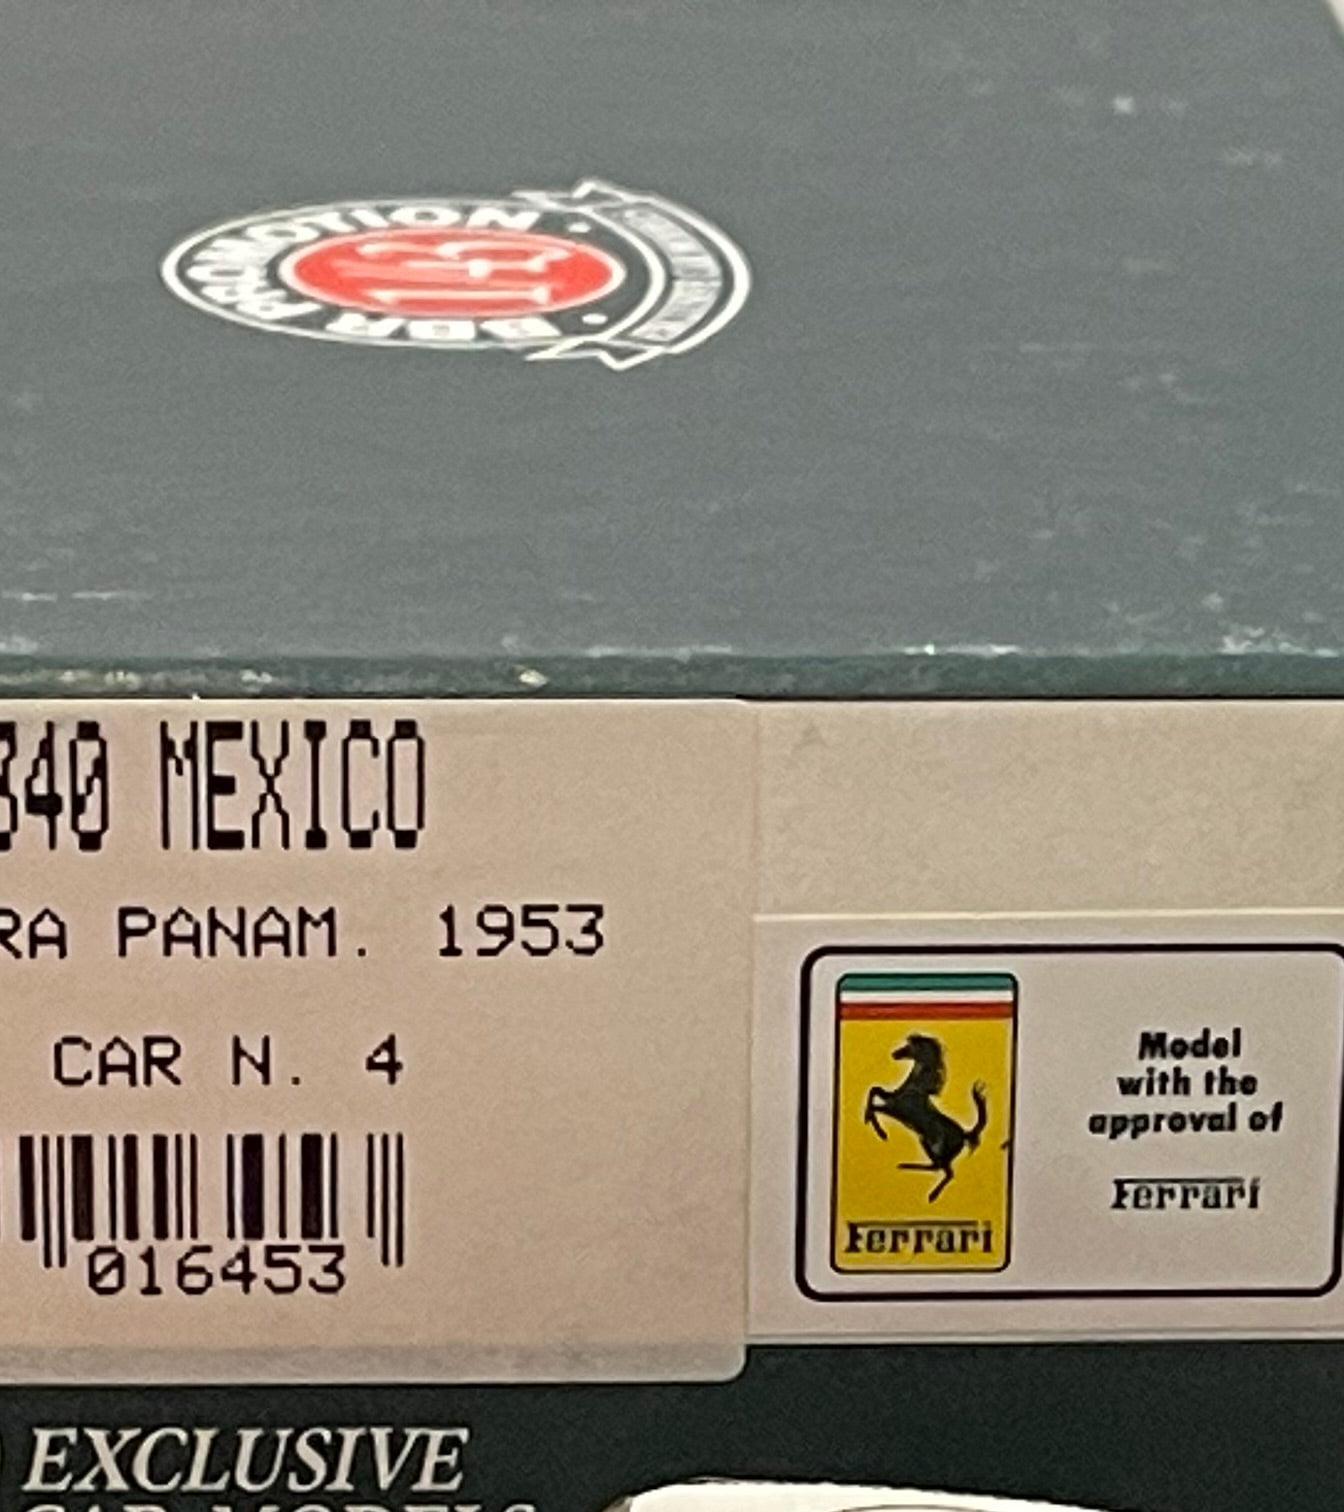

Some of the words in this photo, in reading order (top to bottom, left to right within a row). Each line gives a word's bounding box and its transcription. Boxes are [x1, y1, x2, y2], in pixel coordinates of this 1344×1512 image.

[159, 719, 425, 850] MEXICO
[117, 905, 367, 958] PANAM.
[438, 903, 604, 957] 1953
[54, 1035, 182, 1087] CAR
[232, 1034, 301, 1086] N.
[365, 1033, 403, 1085] 4
[1138, 1028, 1242, 1061] Model
[1117, 1067, 1191, 1097] with
[1204, 1066, 1258, 1096] the
[1088, 1105, 1236, 1140] approval
[1248, 1102, 1284, 1132] of
[1112, 1177, 1260, 1209] Ferrari
[844, 1220, 993, 1254] Ferrari
[88, 1244, 346, 1295] 016453
[22, 1426, 469, 1492] EXCLUSIVE
